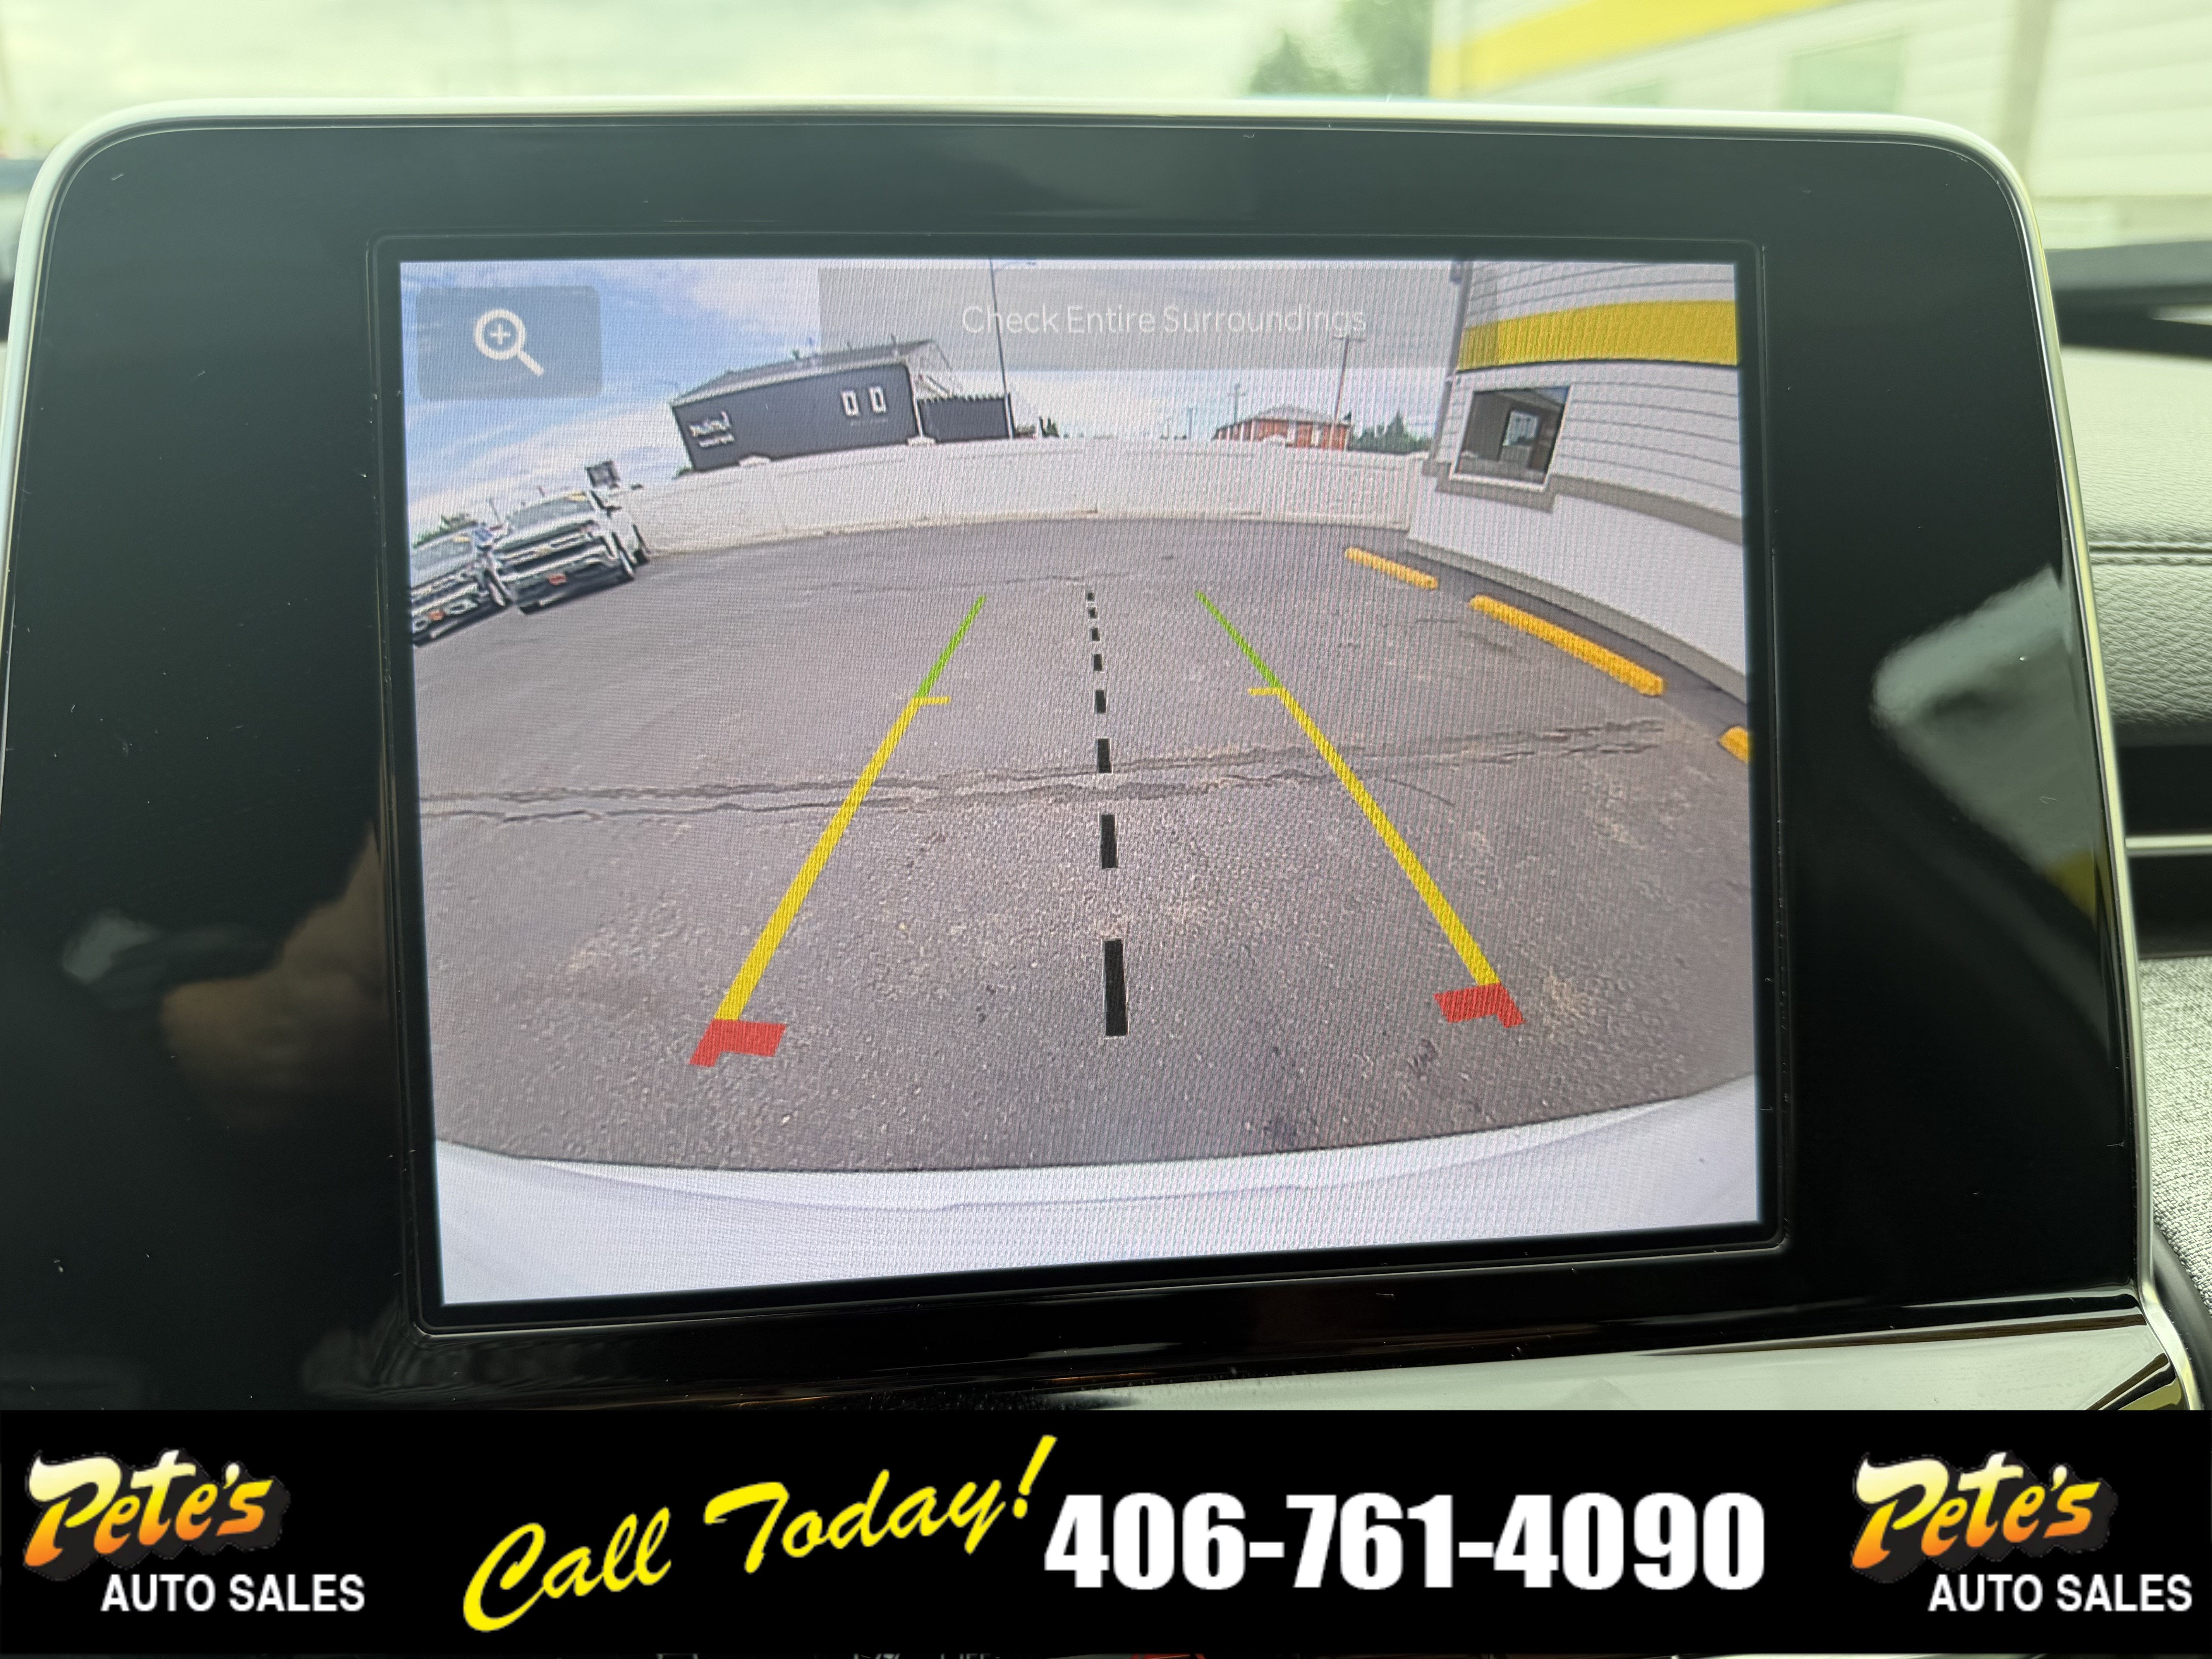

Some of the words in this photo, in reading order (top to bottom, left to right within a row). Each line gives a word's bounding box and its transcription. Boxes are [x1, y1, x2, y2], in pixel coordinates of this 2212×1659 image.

[962, 304, 1060, 333] Check
[1067, 304, 1156, 333] Entire
[1163, 303, 1366, 338] Surroundings
